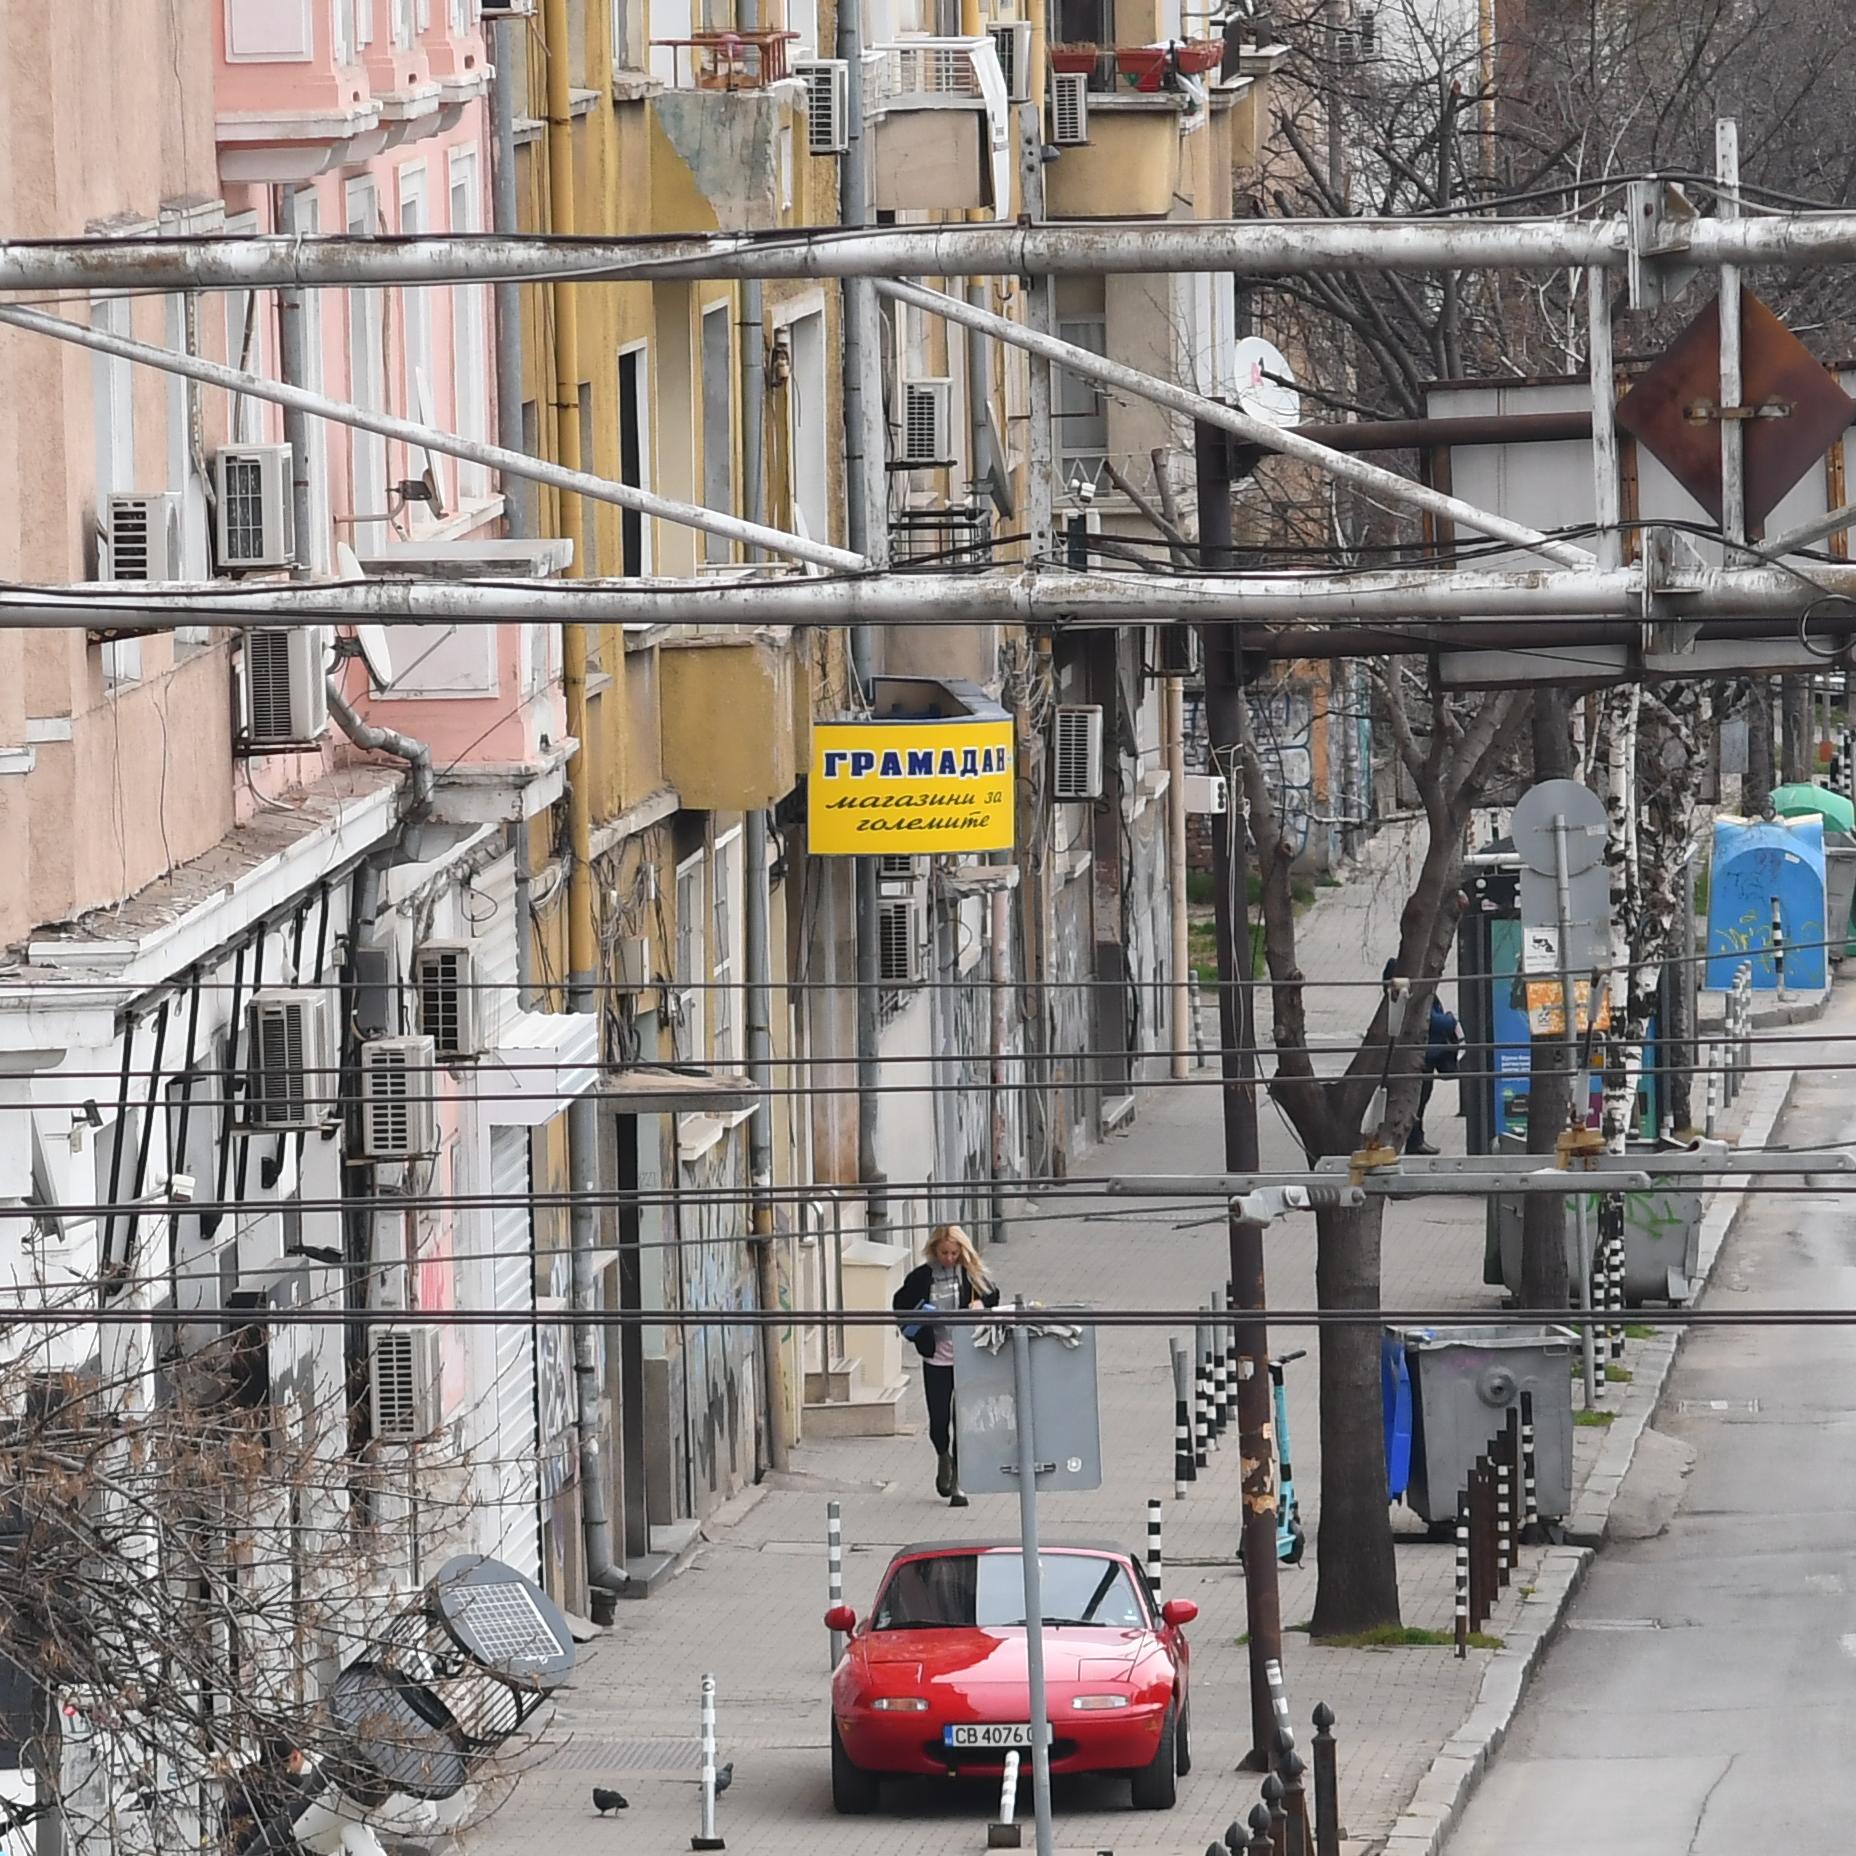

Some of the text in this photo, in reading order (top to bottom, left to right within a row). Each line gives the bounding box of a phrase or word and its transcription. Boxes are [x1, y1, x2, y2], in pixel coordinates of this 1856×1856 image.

[823, 747, 1007, 780] ГРАМАДАН
[824, 791, 1002, 810] магазини за
[856, 811, 991, 832] големите
[982, 1727, 1023, 1744] 4076
